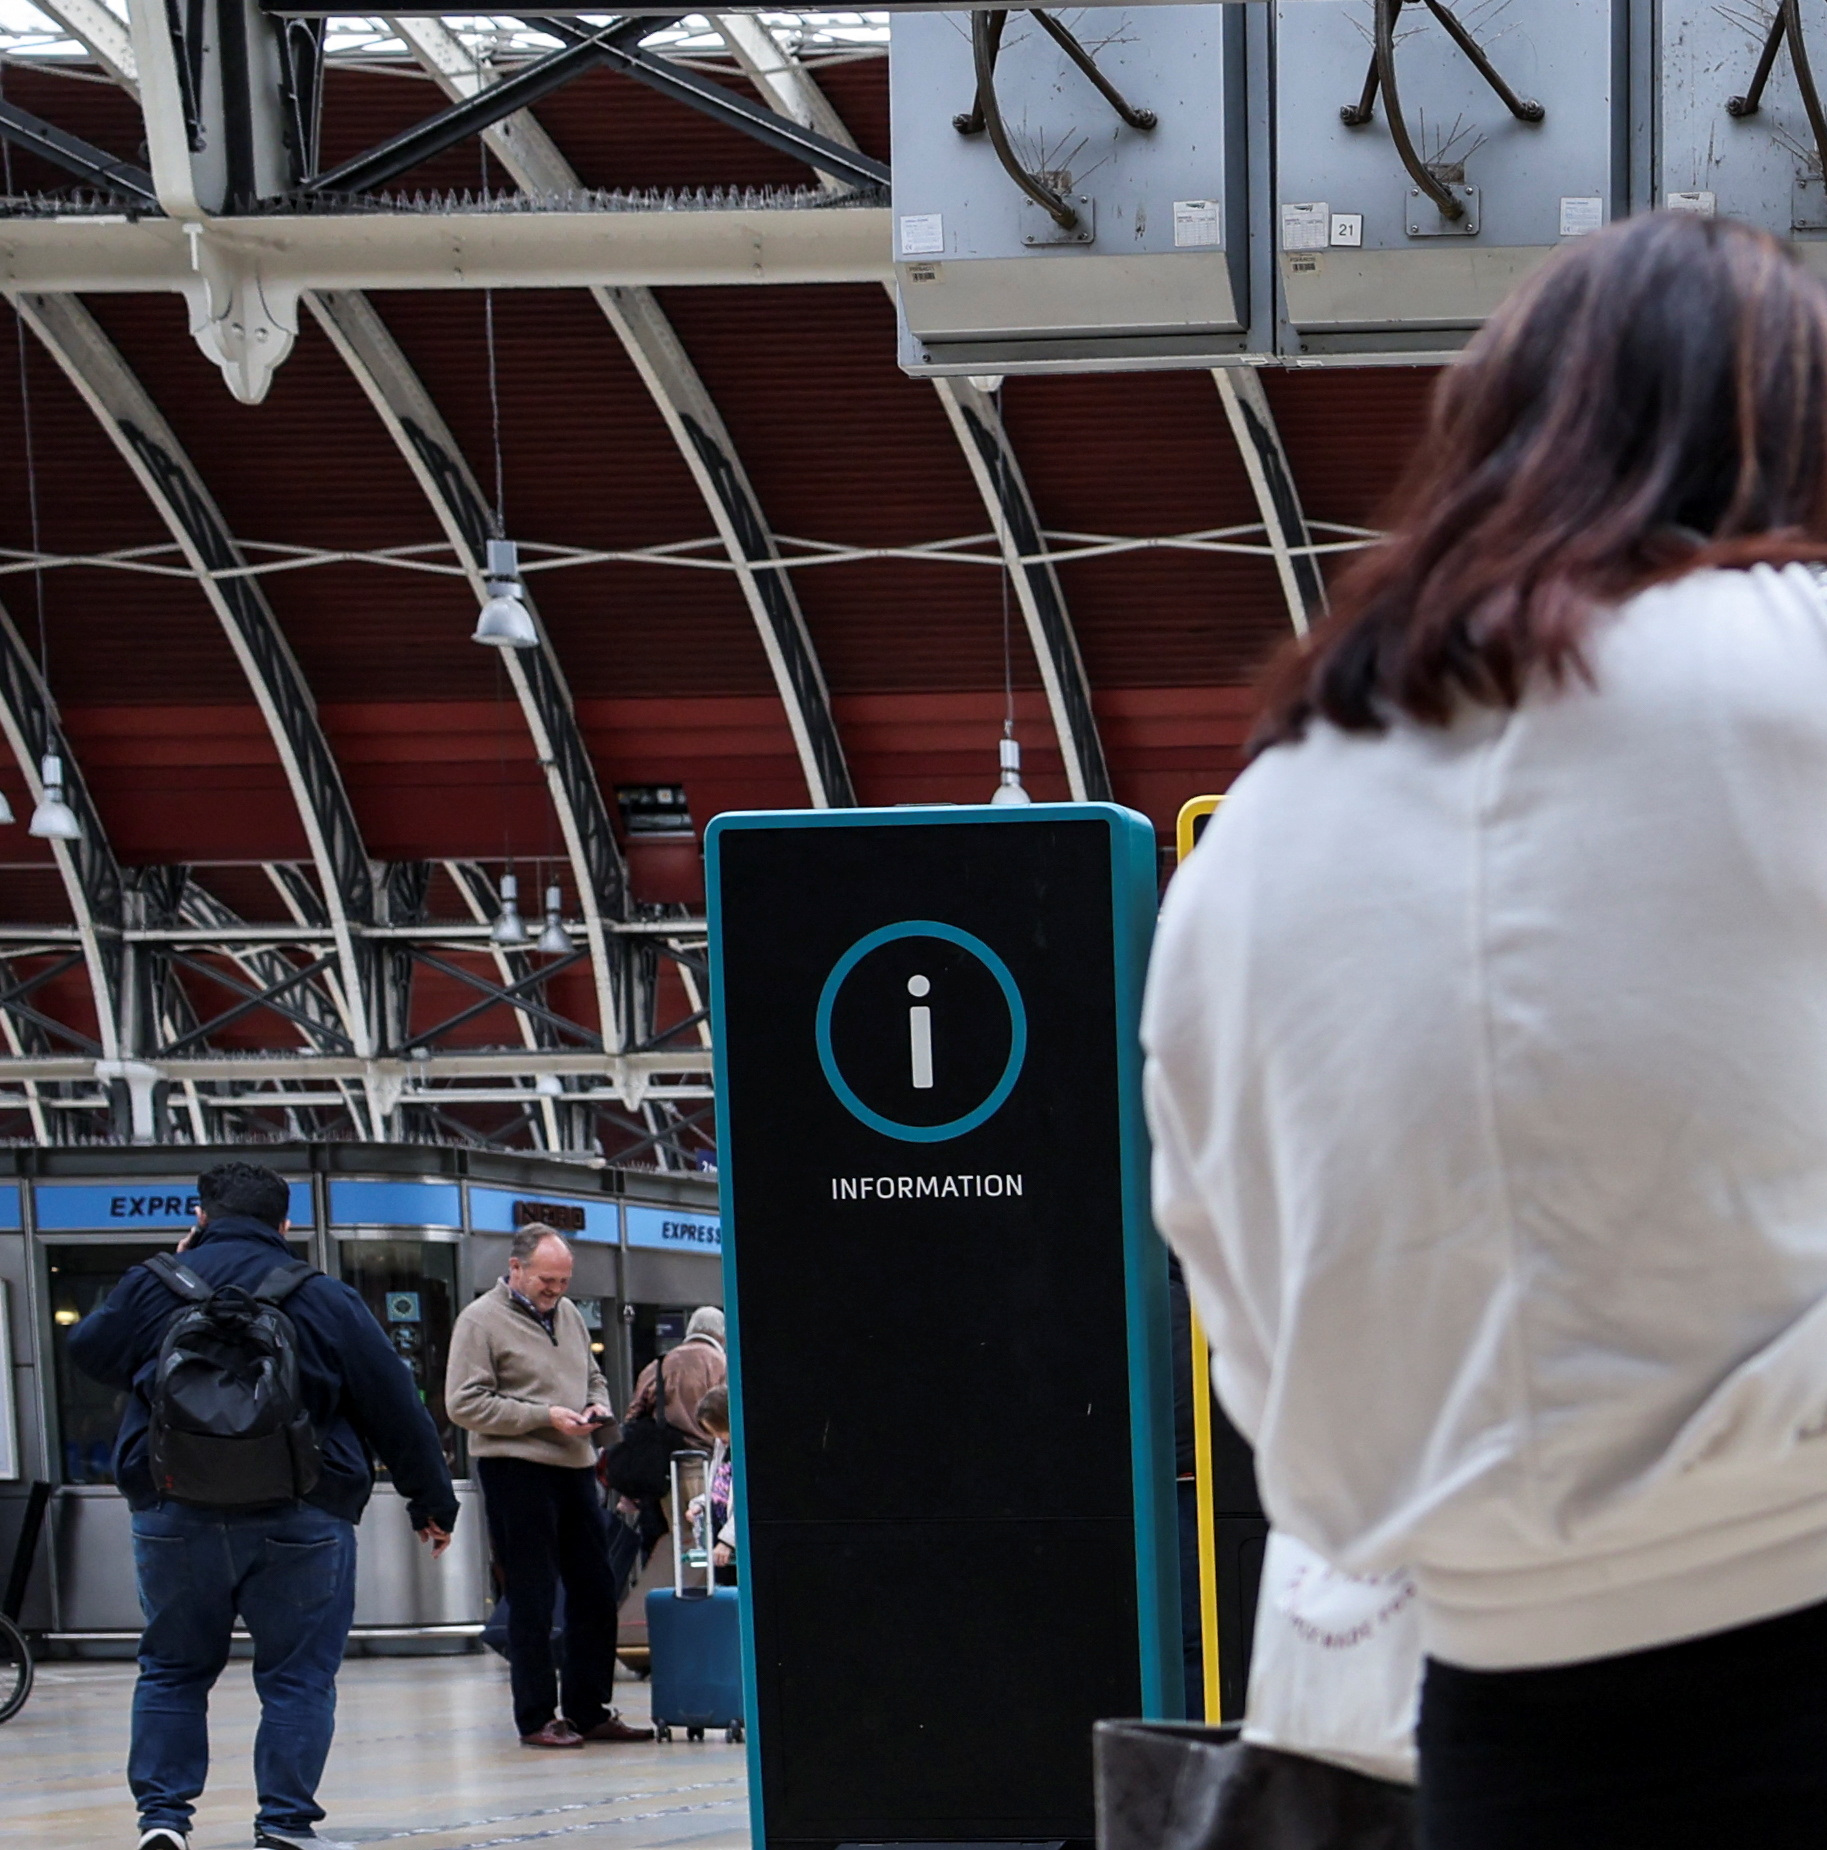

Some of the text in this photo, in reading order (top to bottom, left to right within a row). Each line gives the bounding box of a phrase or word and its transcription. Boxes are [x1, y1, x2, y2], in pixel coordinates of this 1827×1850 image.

[1338, 223, 1354, 237] 21
[832, 1174, 1023, 1200] INFORMATION
[110, 1195, 200, 1217] EXPRE
